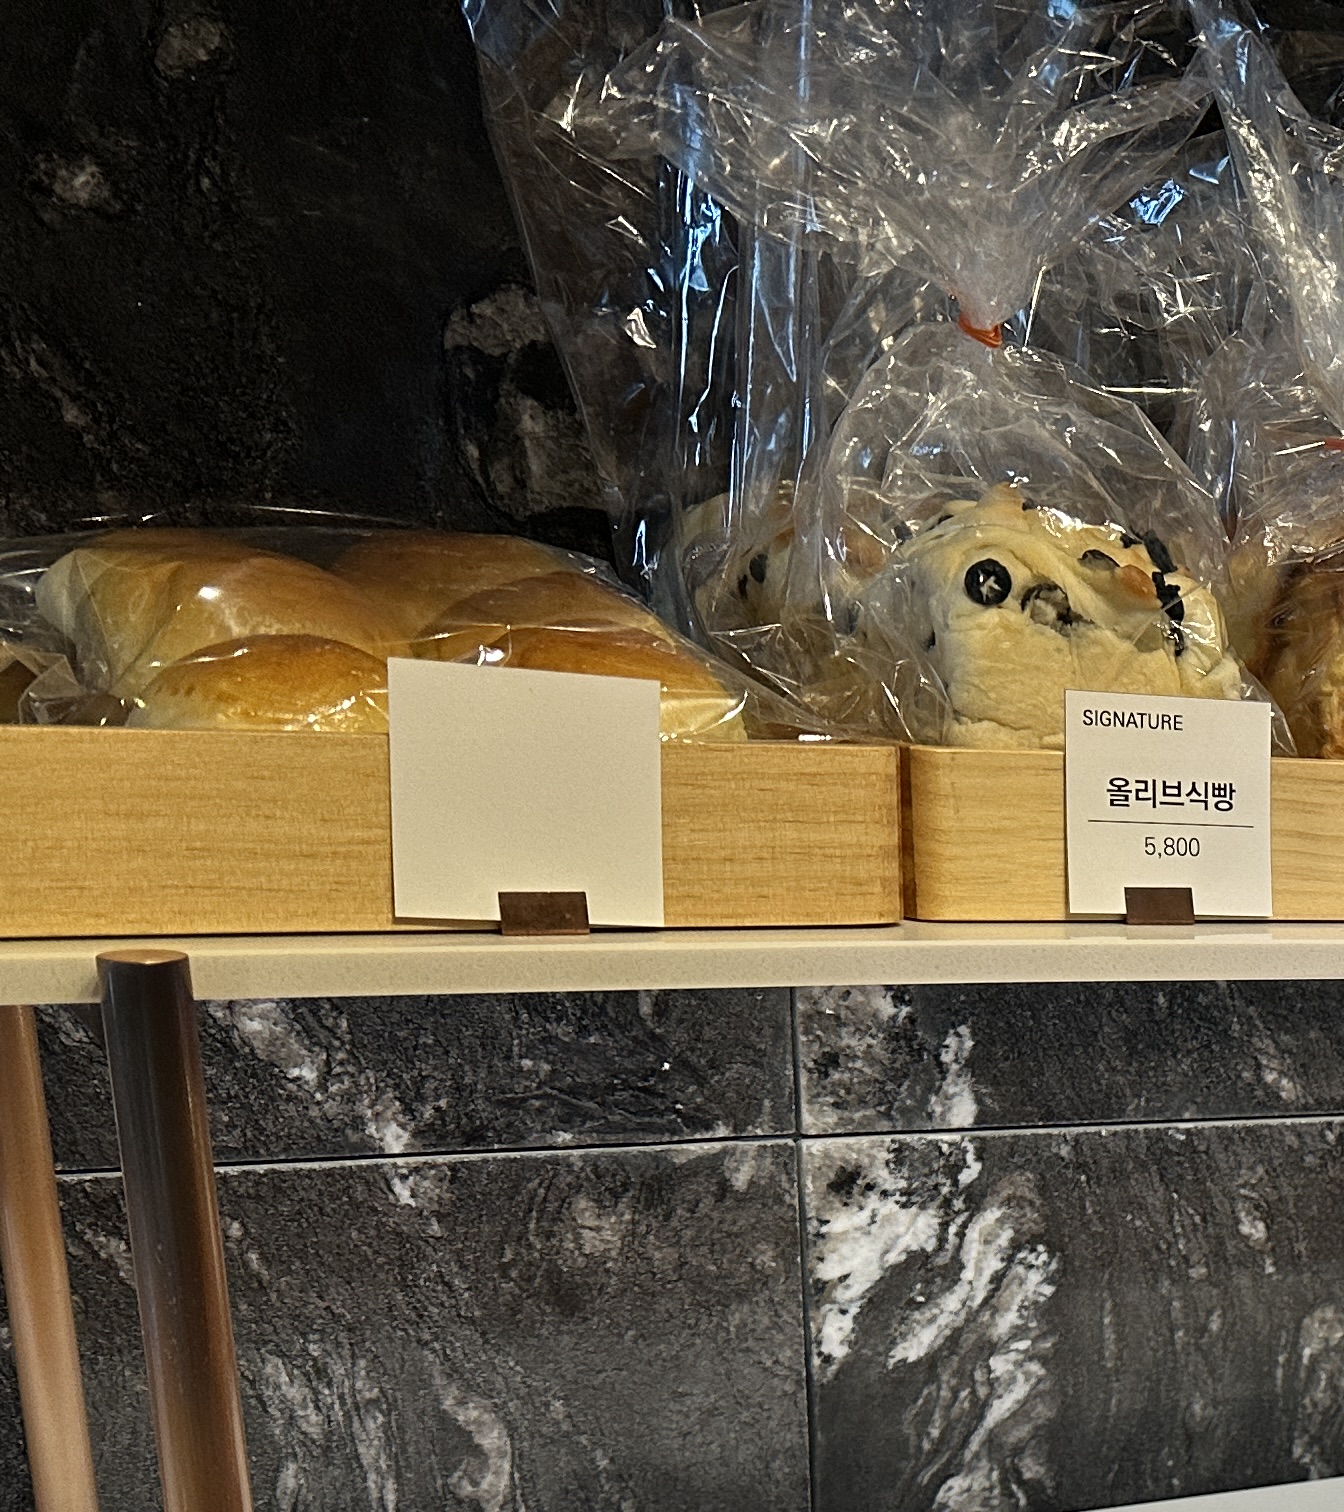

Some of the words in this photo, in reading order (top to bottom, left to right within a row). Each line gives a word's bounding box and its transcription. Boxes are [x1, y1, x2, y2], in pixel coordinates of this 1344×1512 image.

[1082, 708, 1184, 731] SIGNATURE
[1106, 777, 1236, 812] 올리브식빵
[1143, 836, 1201, 859] 5,800
